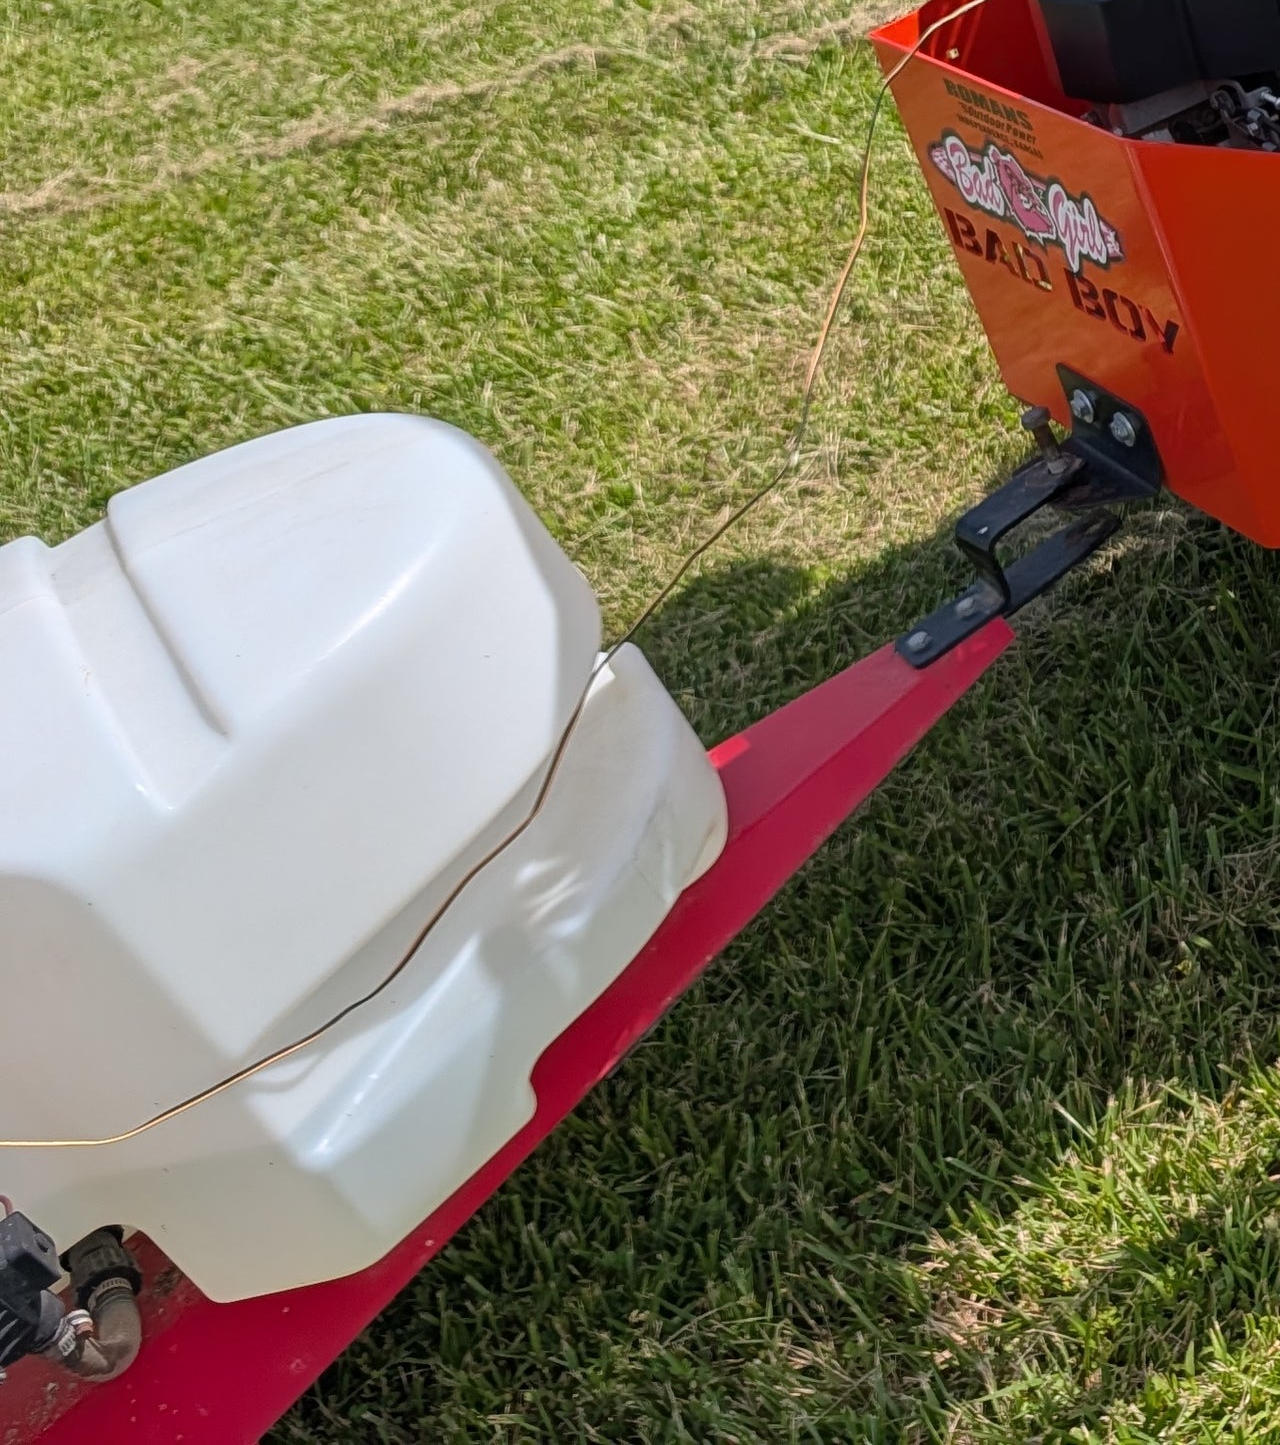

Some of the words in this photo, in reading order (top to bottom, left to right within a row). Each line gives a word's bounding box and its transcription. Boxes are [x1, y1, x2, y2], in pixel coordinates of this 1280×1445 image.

[943, 77, 1034, 131] ROMANS
[946, 136, 1005, 216] Bad
[944, 208, 1052, 292] BAD
[1064, 268, 1180, 354] BOY
